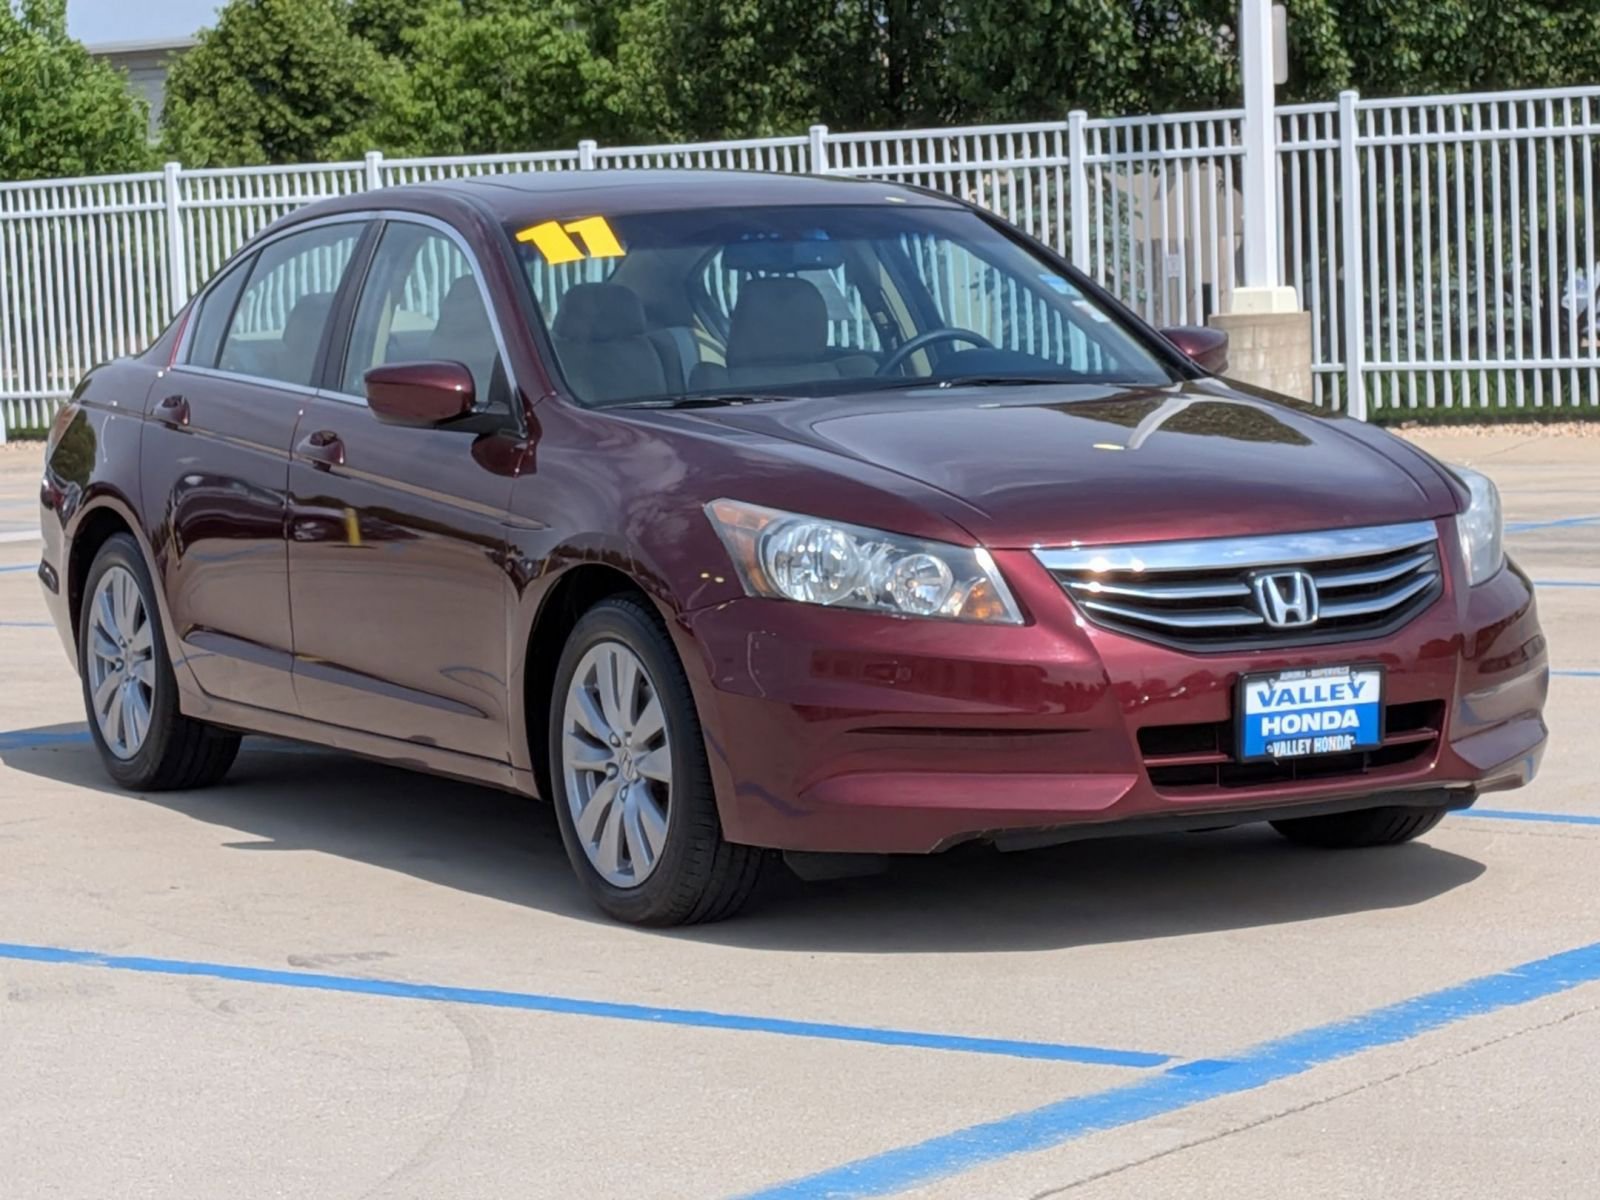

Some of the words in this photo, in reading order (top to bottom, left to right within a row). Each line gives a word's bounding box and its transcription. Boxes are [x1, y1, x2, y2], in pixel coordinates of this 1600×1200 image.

[515, 216, 626, 264] 11
[1258, 681, 1367, 707] VALLEY
[1262, 710, 1359, 736] HONDA
[1274, 739, 1312, 757] VALLEY
[1314, 735, 1351, 753] HONDA
